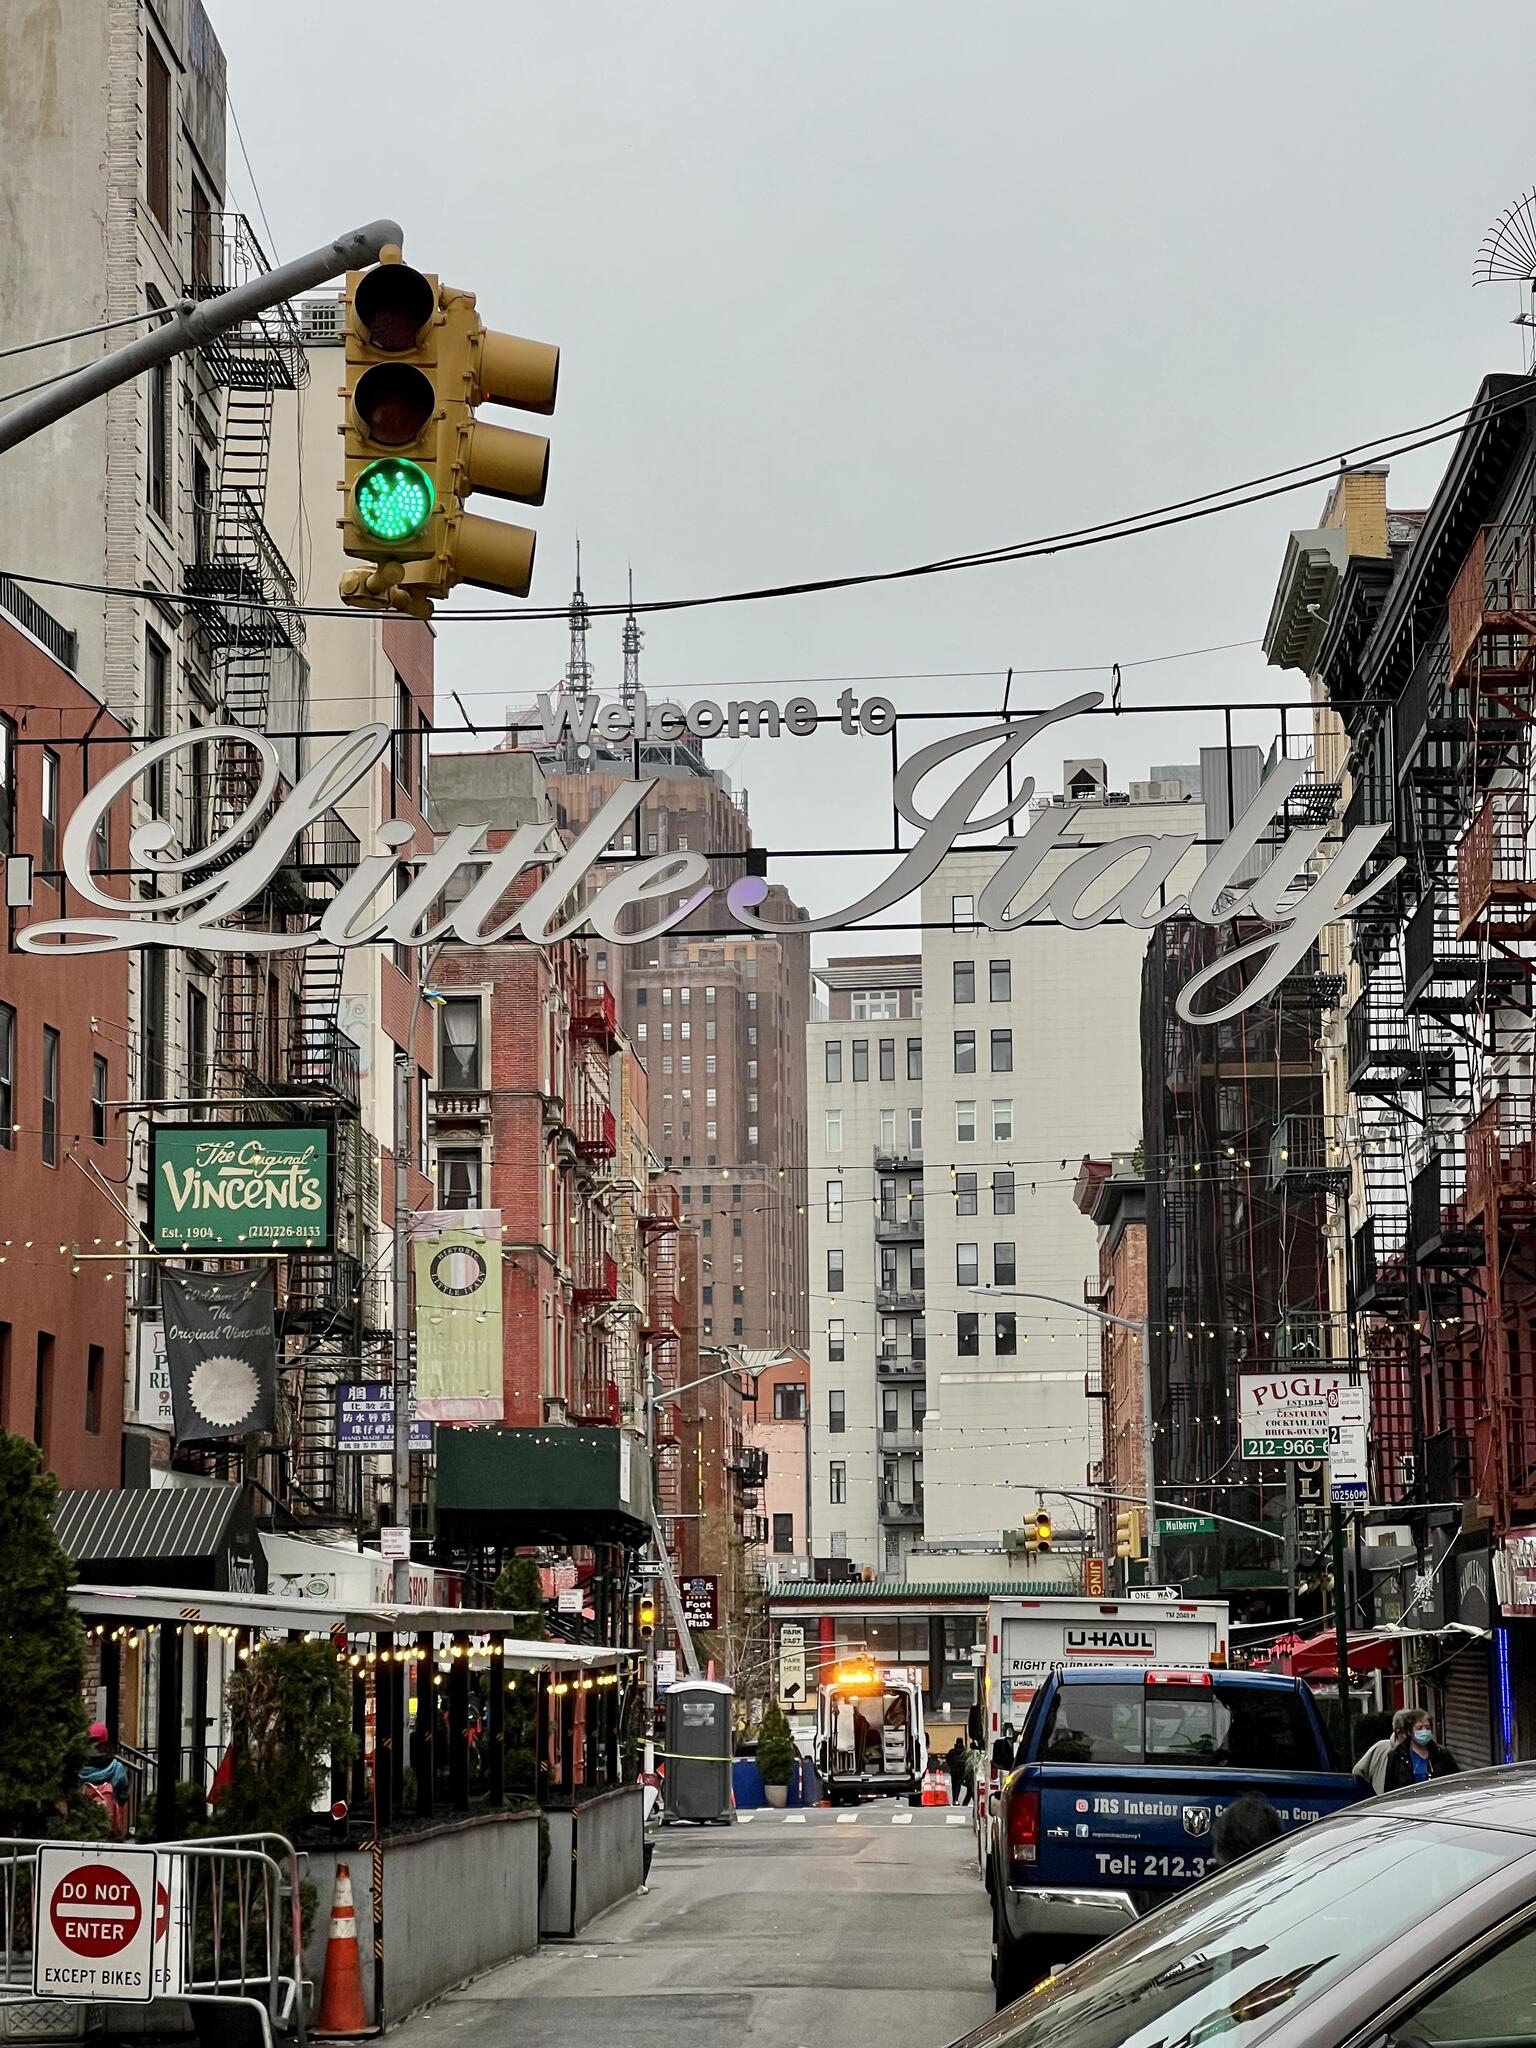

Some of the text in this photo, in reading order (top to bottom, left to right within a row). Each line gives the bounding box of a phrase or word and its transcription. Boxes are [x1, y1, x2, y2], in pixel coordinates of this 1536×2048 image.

[535, 687, 897, 745] Welcome to
[15, 691, 1408, 1026] Little Italy
[196, 1140, 315, 1179] The Oiginal
[161, 1226, 214, 1239] Est. 1904
[248, 1225, 321, 1239] (212)226-8133
[437, 1247, 480, 1260] HISTORIC
[431, 1273, 460, 1296] LITTLE
[208, 1305, 232, 1320] The
[169, 1325, 221, 1344] Original
[1276, 1410, 1328, 1418] ESTAURAN
[1265, 1419, 1327, 1427] COCKTAIL LOU
[1265, 1428, 1319, 1436] BRICK-OVEN
[1248, 1440, 1329, 1456] 212-966-
[1331, 1489, 1359, 1501] 102560
[1165, 1520, 1198, 1532] Mulberry
[1089, 1561, 1103, 1596] JING
[1134, 1590, 1174, 1600] ONE WAY
[685, 1600, 711, 1609] Foot
[684, 1611, 713, 1620] Back
[687, 1620, 710, 1628] Rub
[1067, 1631, 1153, 1648] U-HAUL
[1013, 1660, 1047, 1671] RIGHT
[1093, 1798, 1119, 1814] JRS
[1124, 1799, 1178, 1817] Interior
[1096, 1853, 1137, 1875] Tel:
[62, 1882, 131, 1901] DO NOT
[65, 1921, 125, 1940] ENTER
[45, 1967, 97, 1984] EXCEPT
[101, 1970, 142, 1986] BIKES
